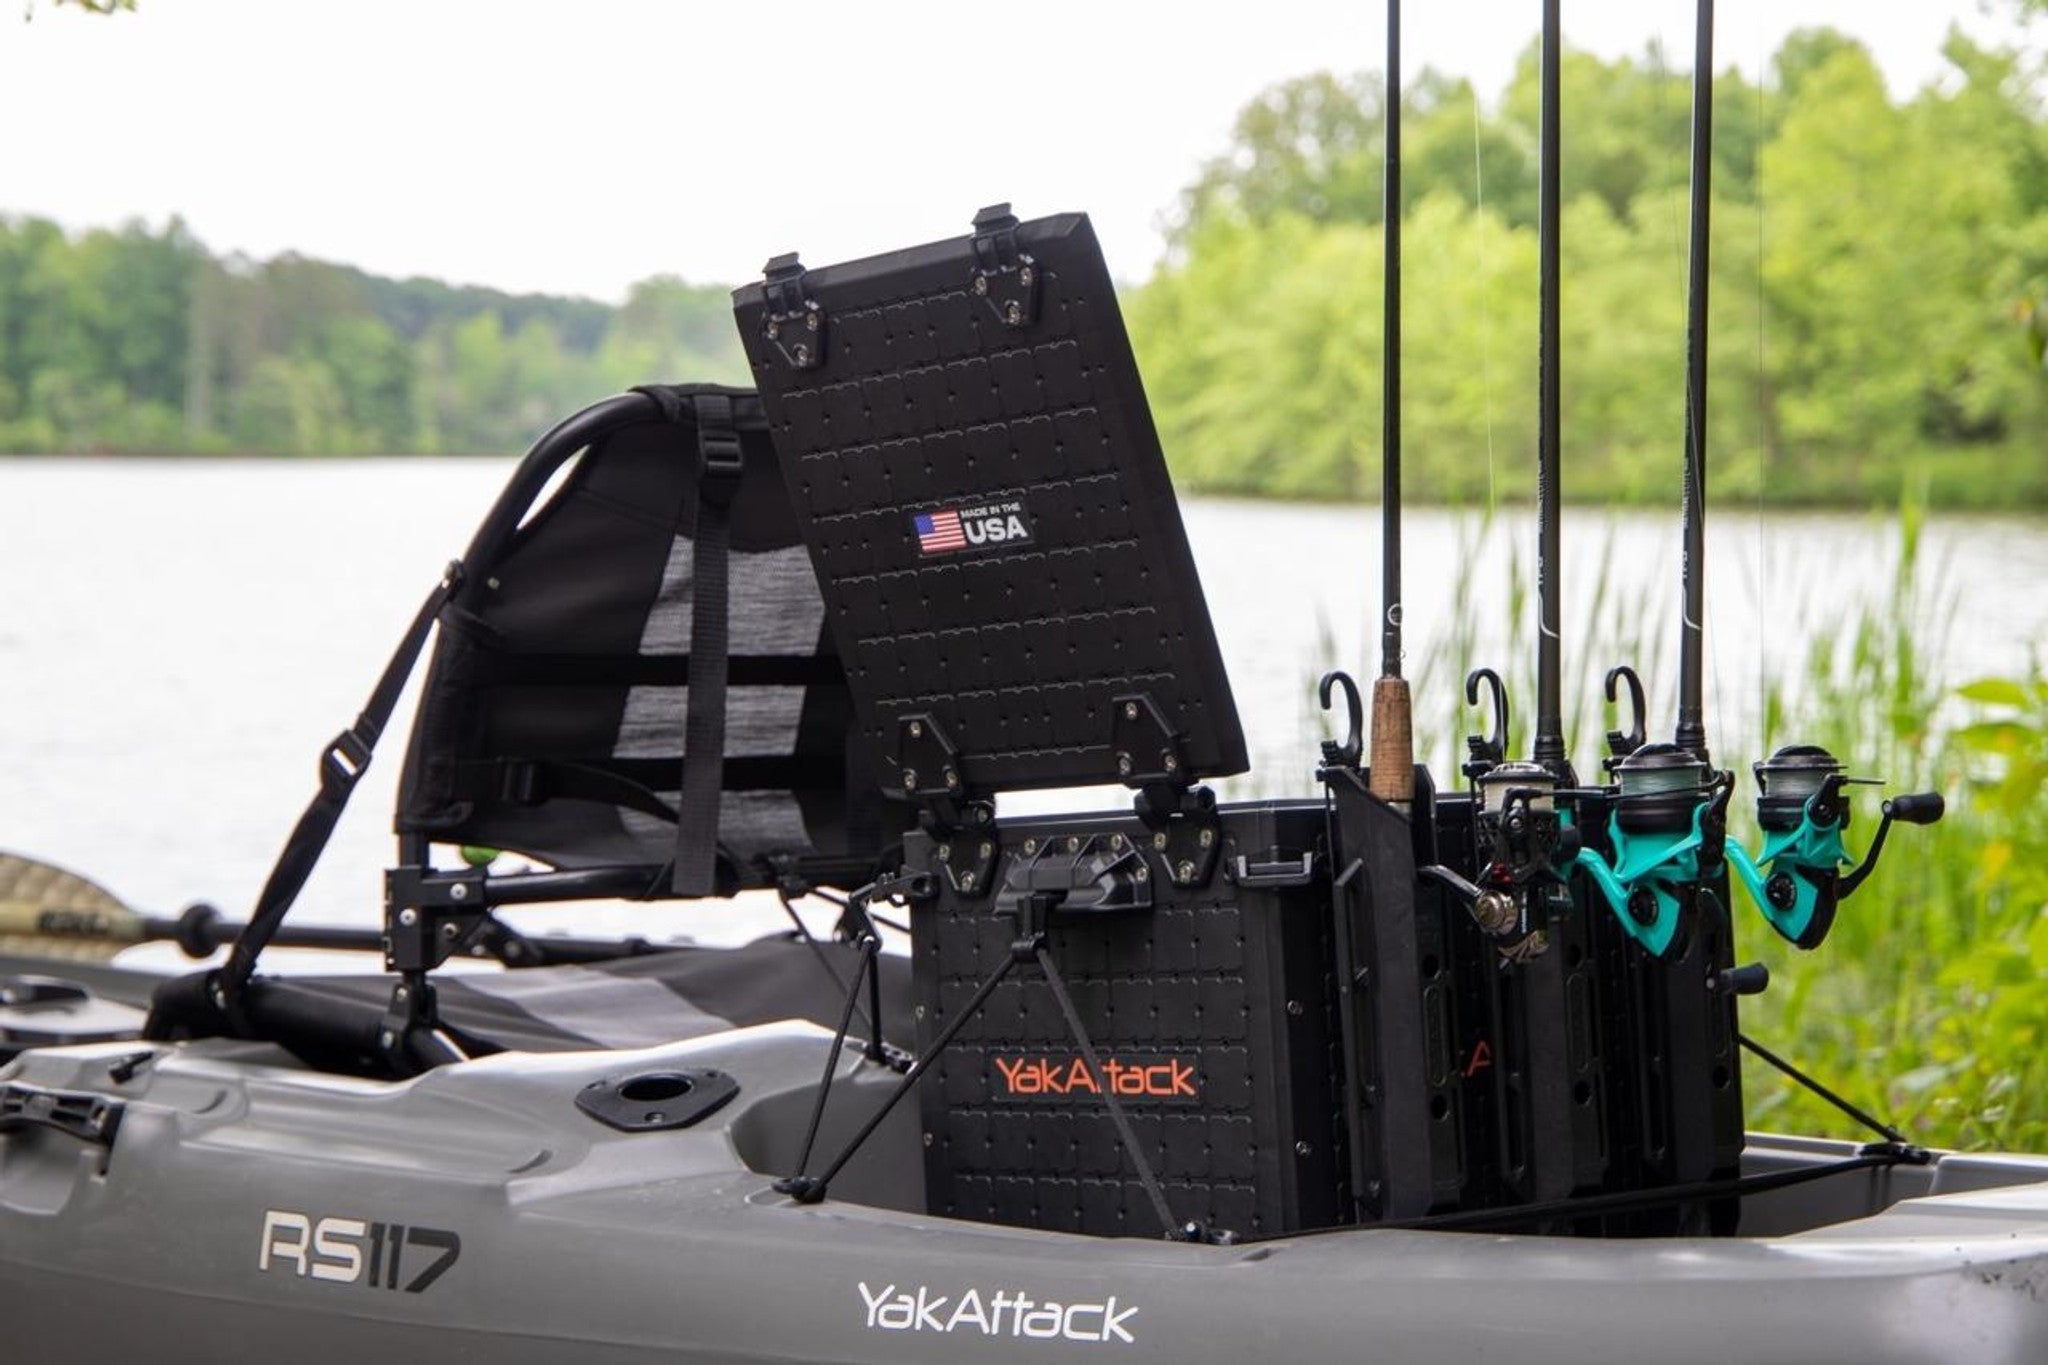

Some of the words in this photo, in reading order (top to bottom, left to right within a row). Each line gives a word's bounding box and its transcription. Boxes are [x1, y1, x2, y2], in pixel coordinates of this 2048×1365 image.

[960, 506, 988, 518] MADE
[989, 504, 1000, 515] IN
[1001, 501, 1021, 513] THE
[964, 514, 1029, 544] USA
[996, 1057, 1196, 1096] YakAtack
[259, 1210, 461, 1294] RS117
[857, 1281, 1139, 1344] YakAttack
